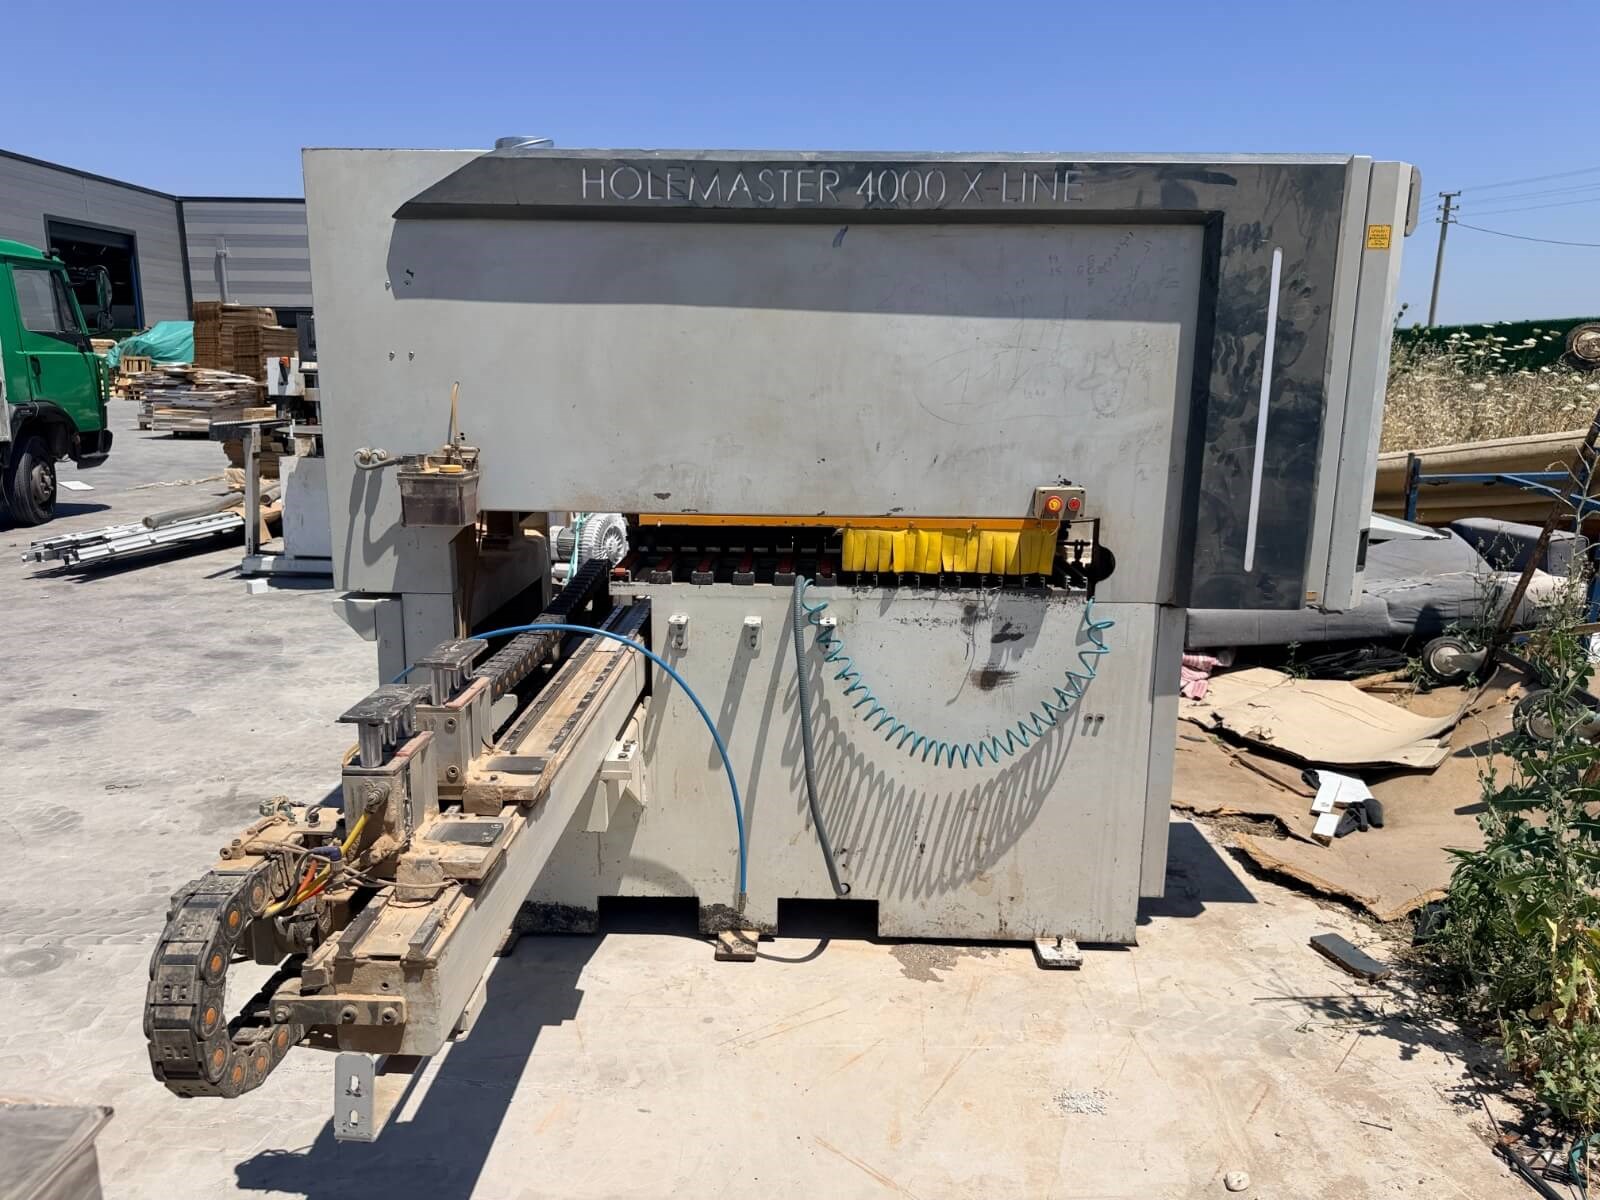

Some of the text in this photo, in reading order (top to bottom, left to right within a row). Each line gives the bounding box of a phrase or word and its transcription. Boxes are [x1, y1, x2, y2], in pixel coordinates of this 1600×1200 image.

[582, 166, 1083, 203] HOLEMASTER 4000 X-LINE
